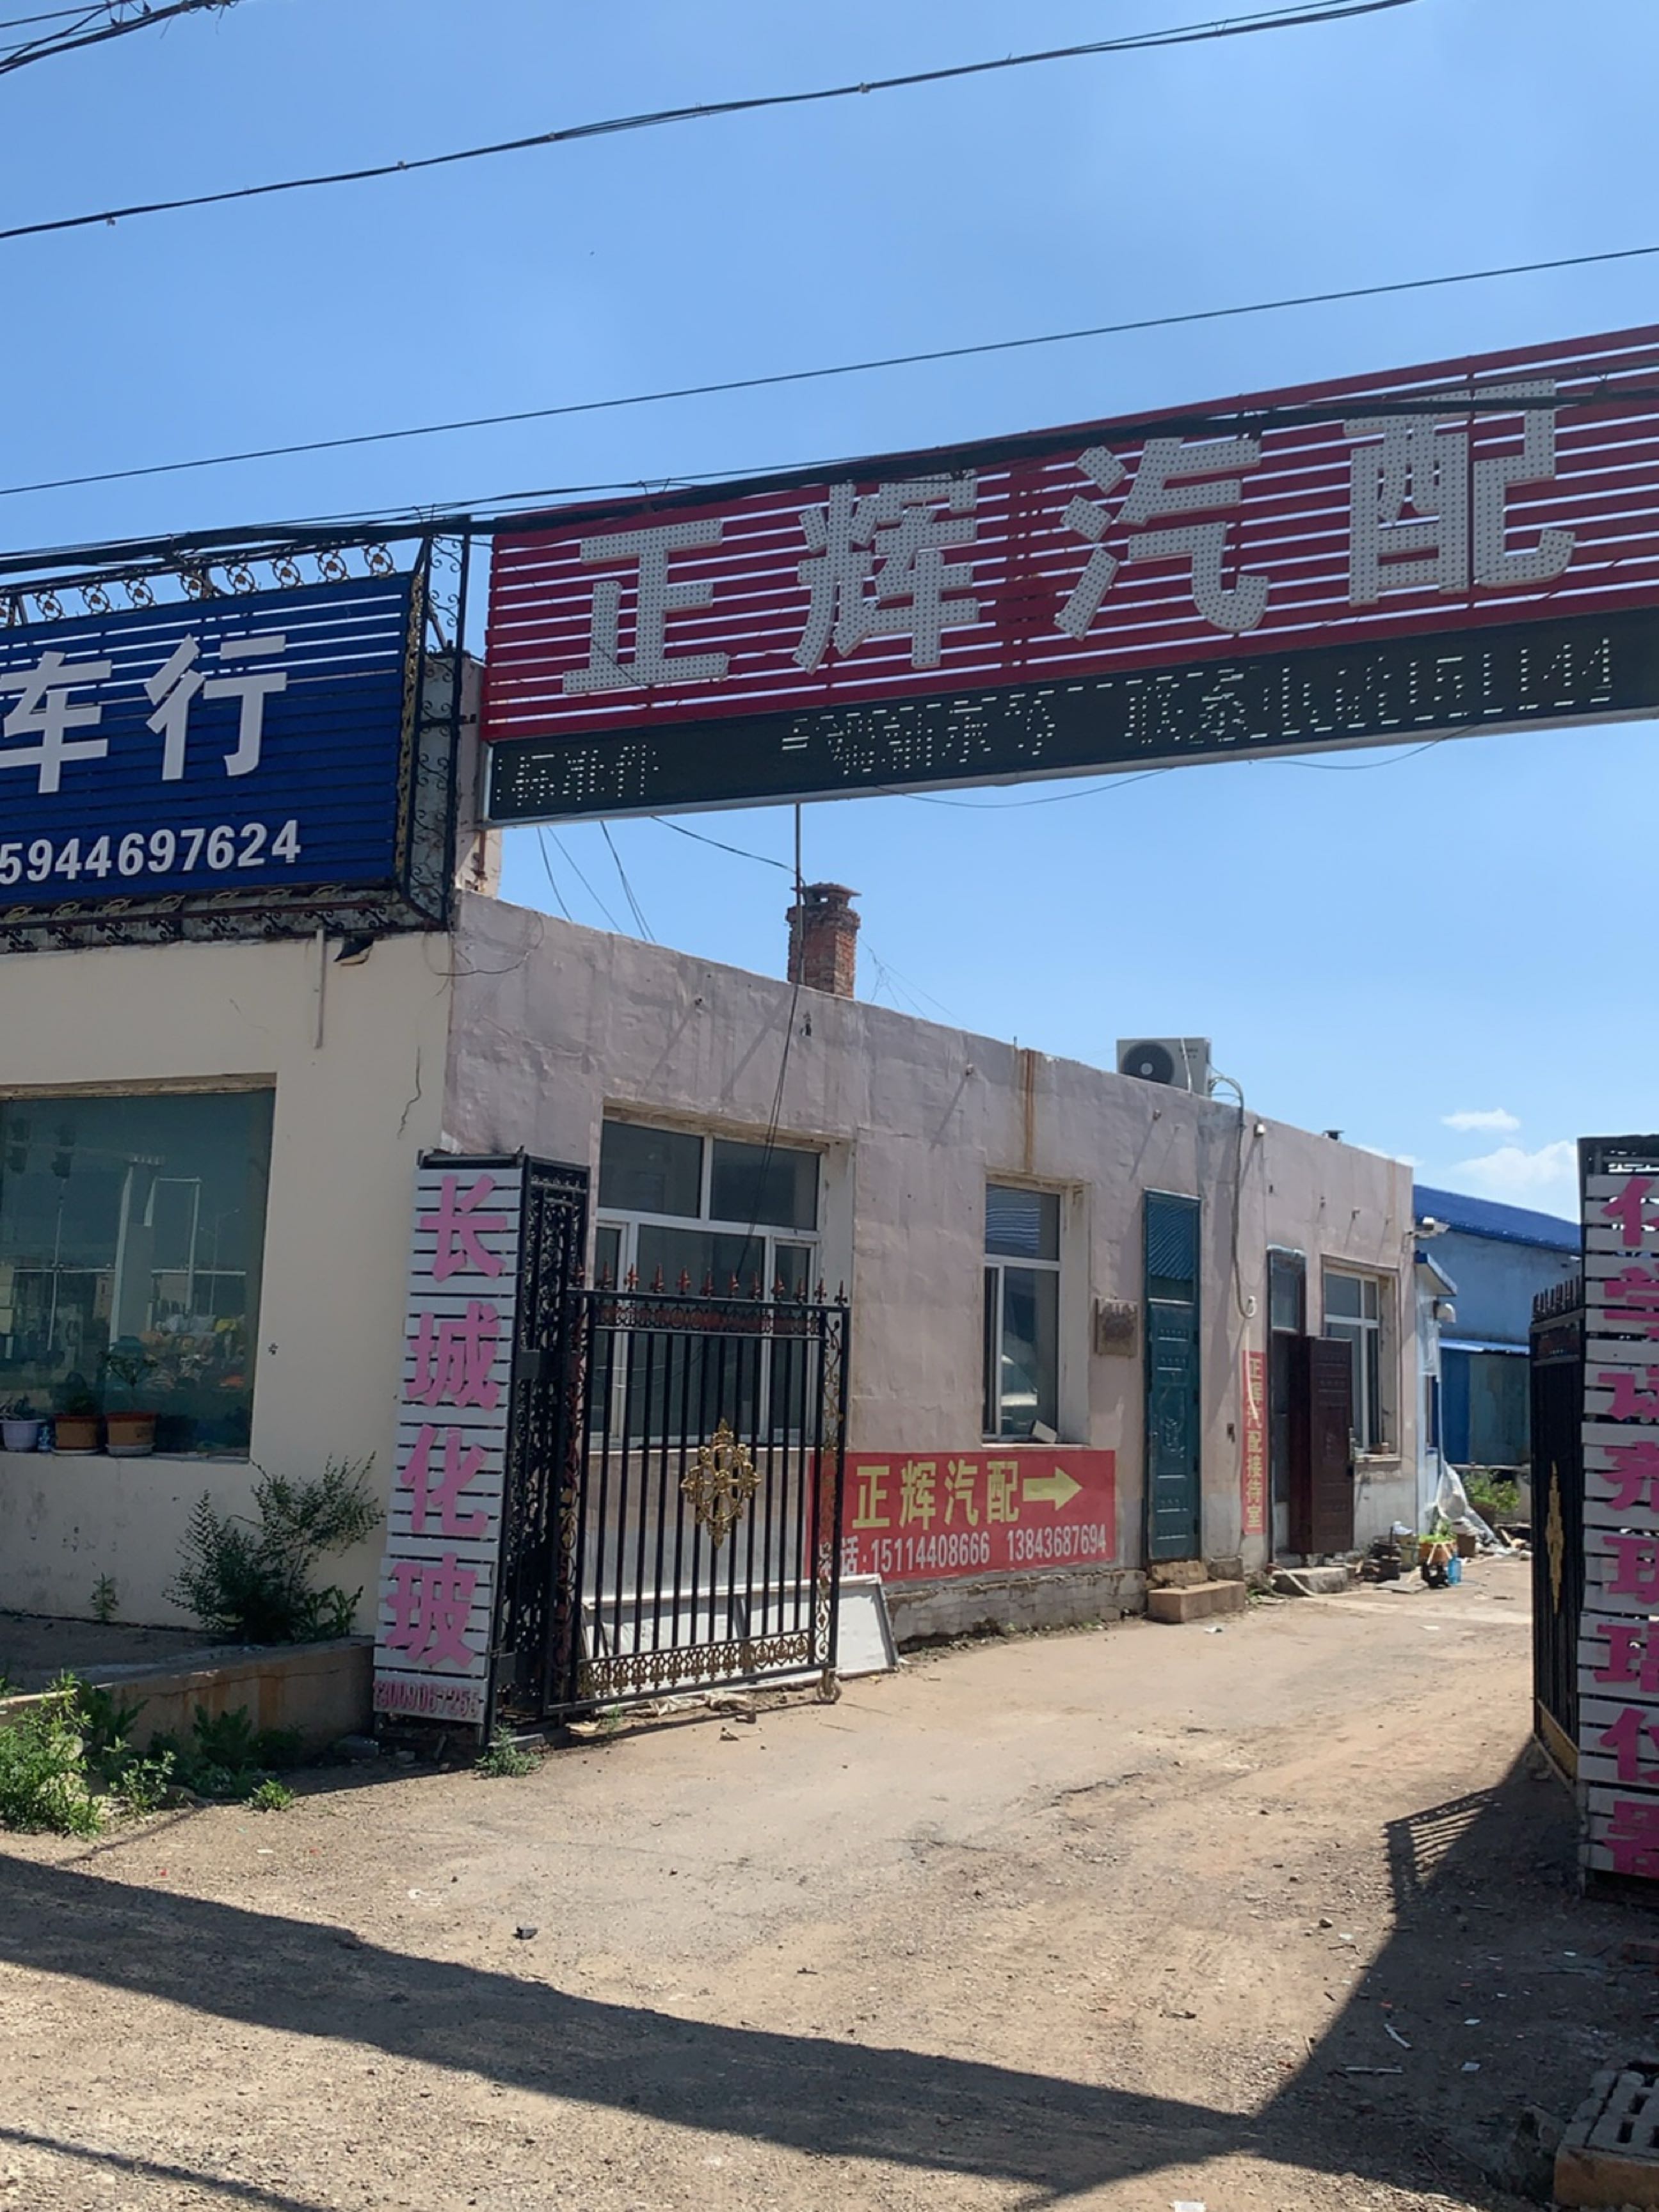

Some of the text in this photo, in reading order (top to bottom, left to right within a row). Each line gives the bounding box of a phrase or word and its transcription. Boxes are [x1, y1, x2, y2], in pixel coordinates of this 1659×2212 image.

[563, 378, 1577, 694] 正辉汽配
[0, 633, 287, 794] 车行
[0, 819, 301, 885] 5944697624
[385, 1174, 508, 1667] 长城化玻
[852, 1459, 1020, 1531] 正辉汽配
[1007, 1523, 1107, 1562] 13843687694
